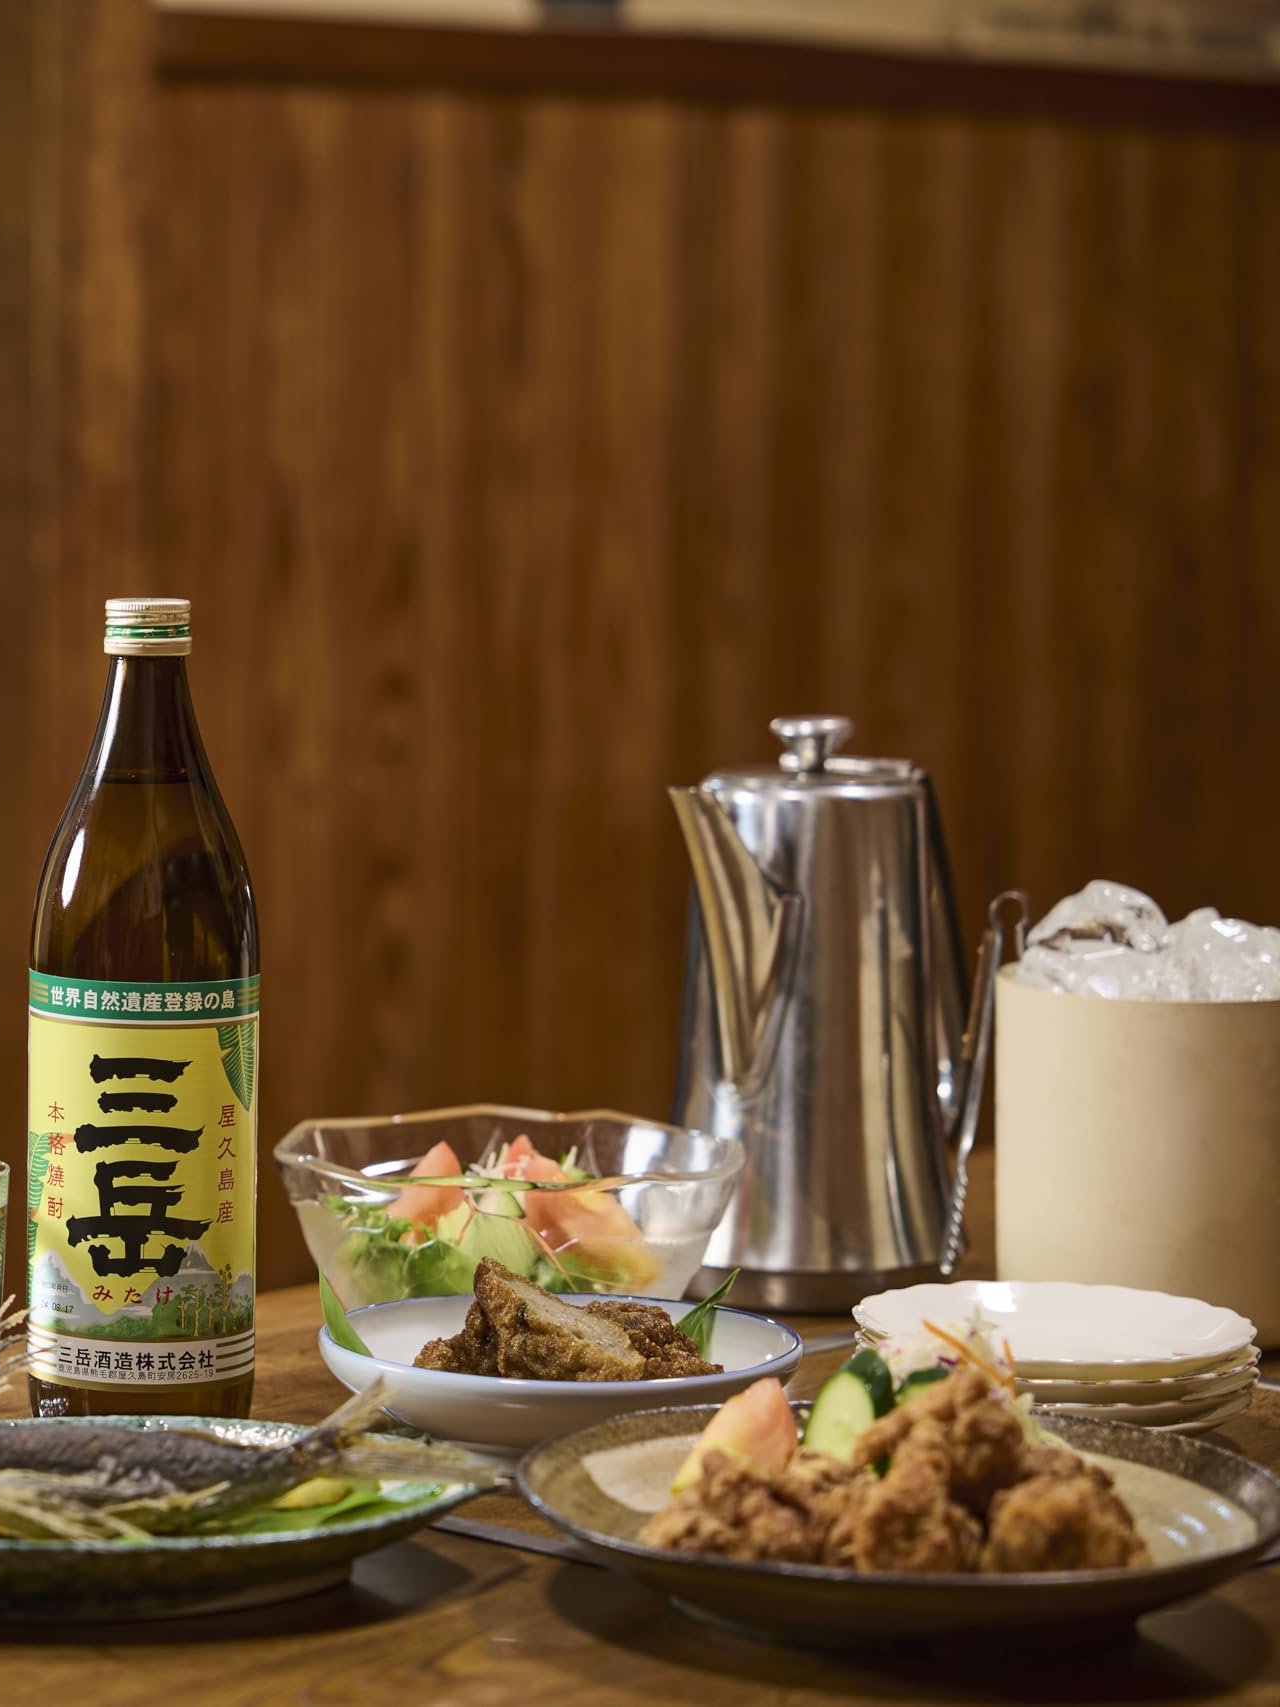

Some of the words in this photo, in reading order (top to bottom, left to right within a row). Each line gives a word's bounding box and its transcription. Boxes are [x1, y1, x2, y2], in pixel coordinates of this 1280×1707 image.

[50, 985, 236, 1012] 世界自然遺産登録の島
[66, 1054, 213, 1278] 三岳
[216, 1104, 236, 1224] 屋久島産
[93, 1285, 174, 1306] みたけ
[58, 1346, 214, 1371] 三岳酒造株式会社
